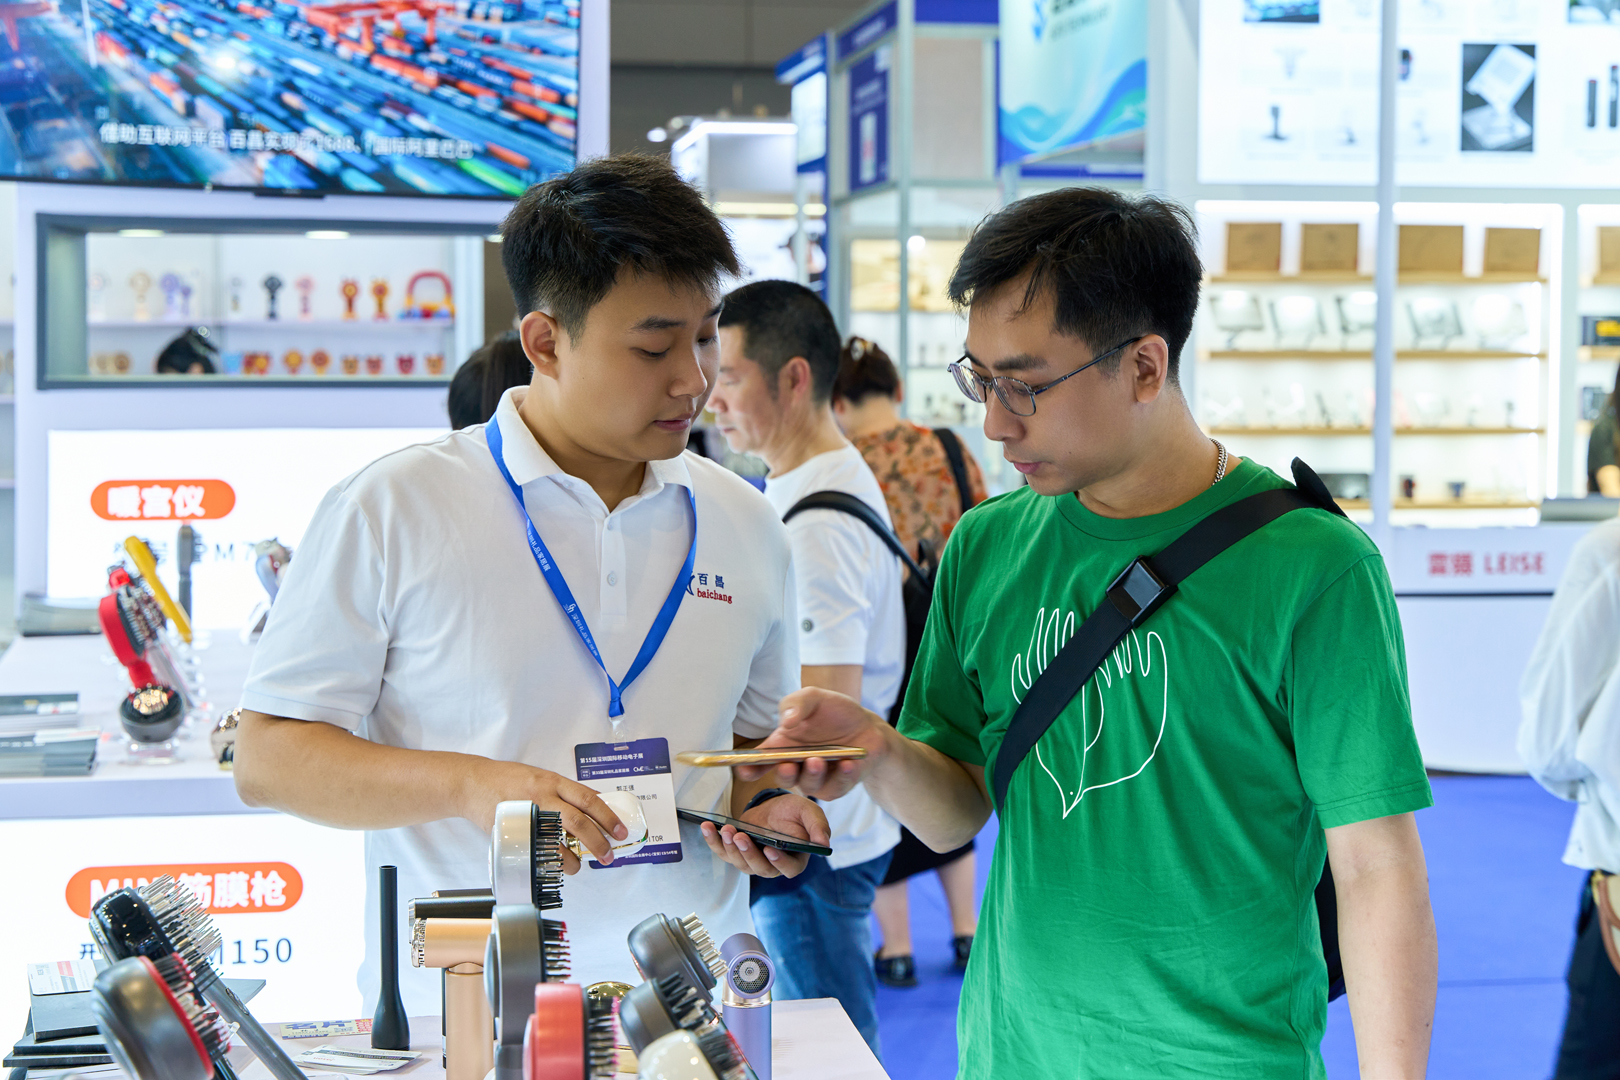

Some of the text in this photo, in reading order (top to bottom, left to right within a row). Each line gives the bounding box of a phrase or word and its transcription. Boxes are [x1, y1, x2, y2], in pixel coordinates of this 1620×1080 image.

[1484, 552, 1546, 575] LEISE
[697, 588, 732, 604] baichang
[90, 870, 287, 910] M筋膜枪
